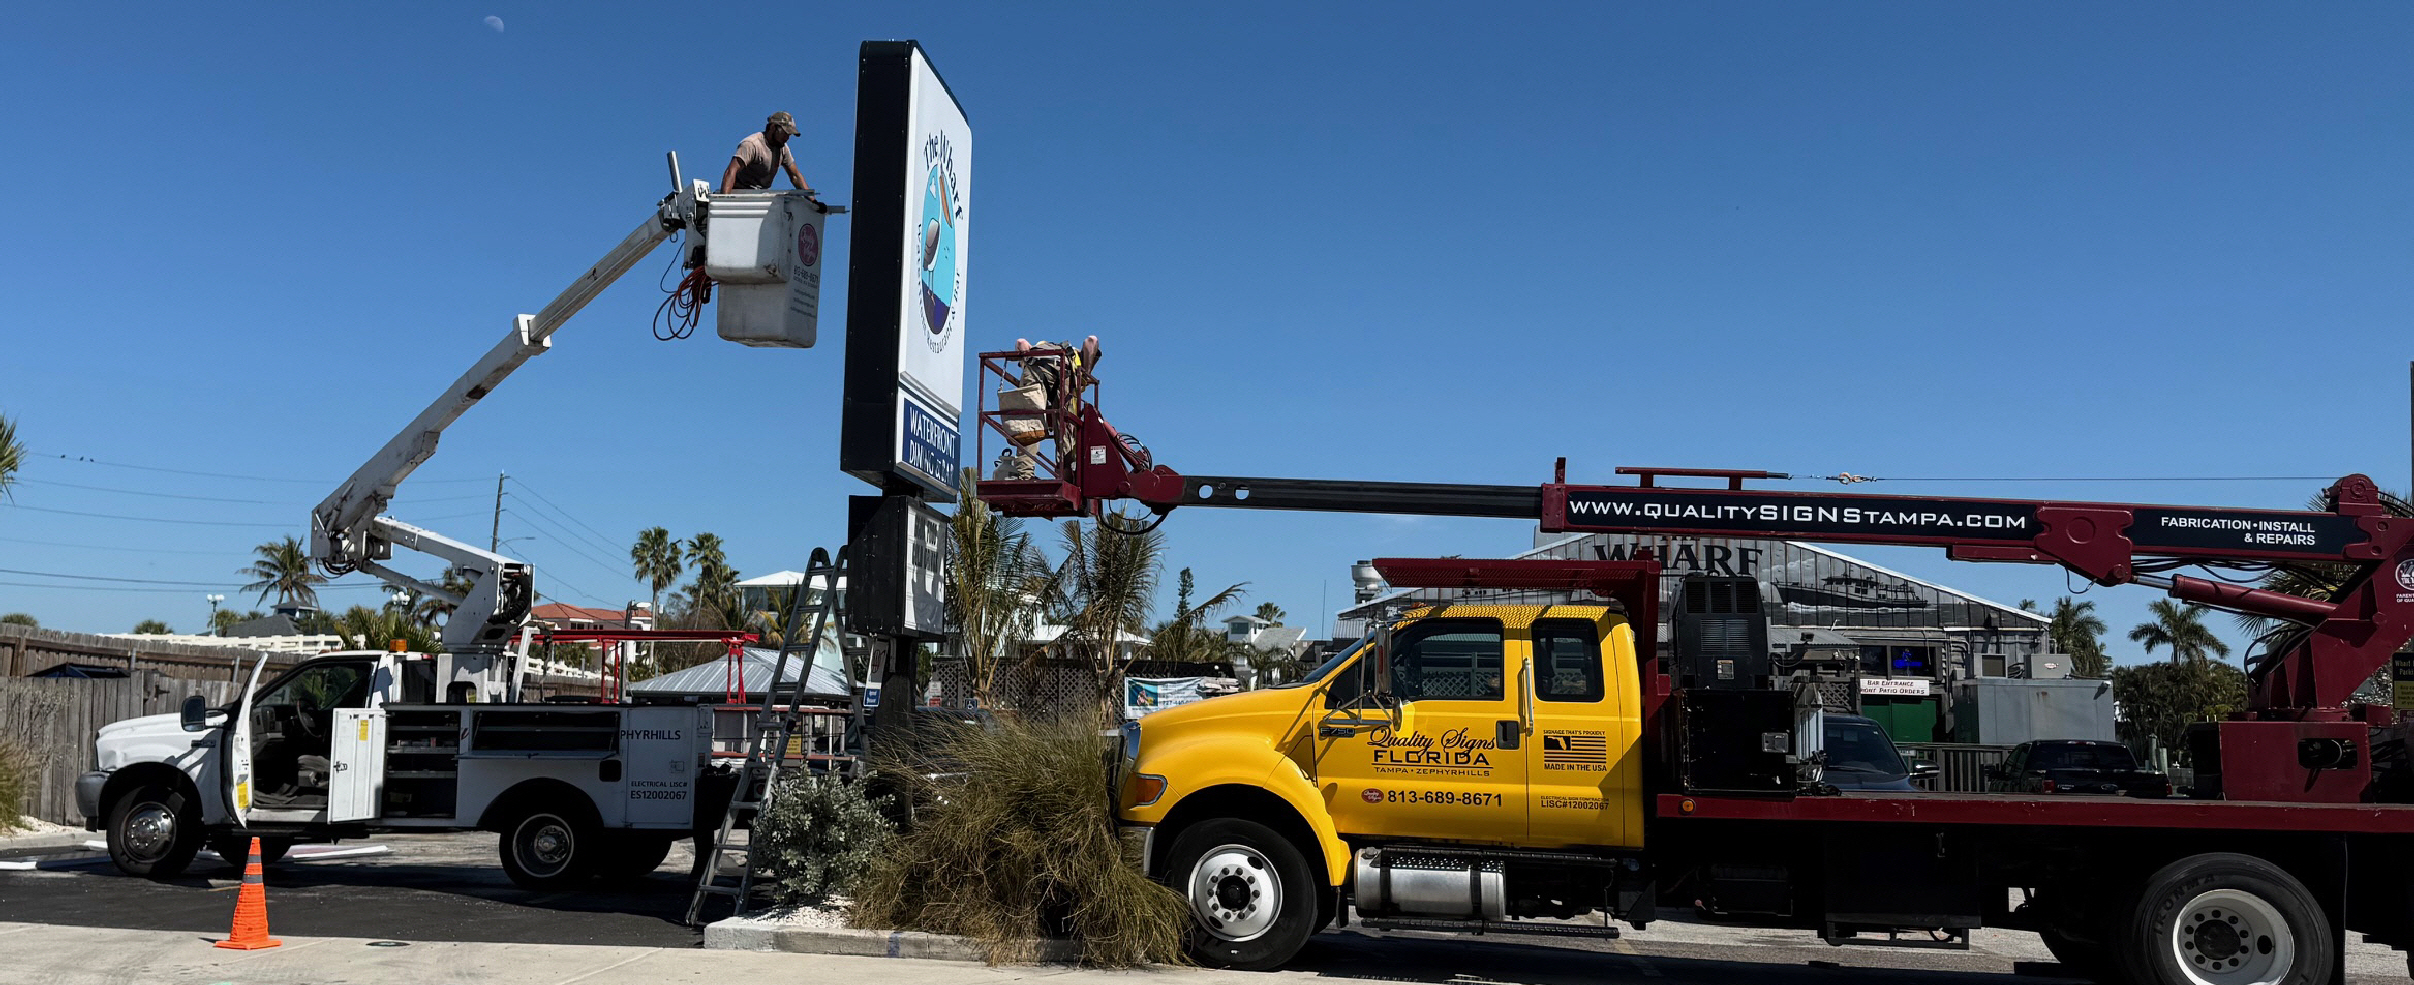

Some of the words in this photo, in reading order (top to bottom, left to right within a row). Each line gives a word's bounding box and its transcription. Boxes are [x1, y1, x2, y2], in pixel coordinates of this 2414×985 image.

[923, 131, 939, 171] The
[940, 128, 963, 220] Wharf
[909, 406, 956, 459] WATERFRONT
[909, 439, 935, 475] DINING
[2244, 532, 2253, 543] &
[2256, 532, 2316, 546] REPAIRS
[1879, 686, 1898, 694] PATIO
[1899, 687, 1926, 695] ORDERS
[620, 729, 681, 741] PHYRHILLS
[1366, 725, 1434, 757] Quality
[1440, 727, 1496, 758] Signs
[1373, 749, 1490, 766] FLORIDA
[1374, 766, 1409, 774] TAMPA
[1415, 767, 1490, 777] ZEPHYRHILLS
[1544, 763, 1565, 771] MADE
[1592, 764, 1608, 772] USA
[630, 790, 688, 800] ES12002067
[1387, 789, 1502, 808] 813-689-8671
